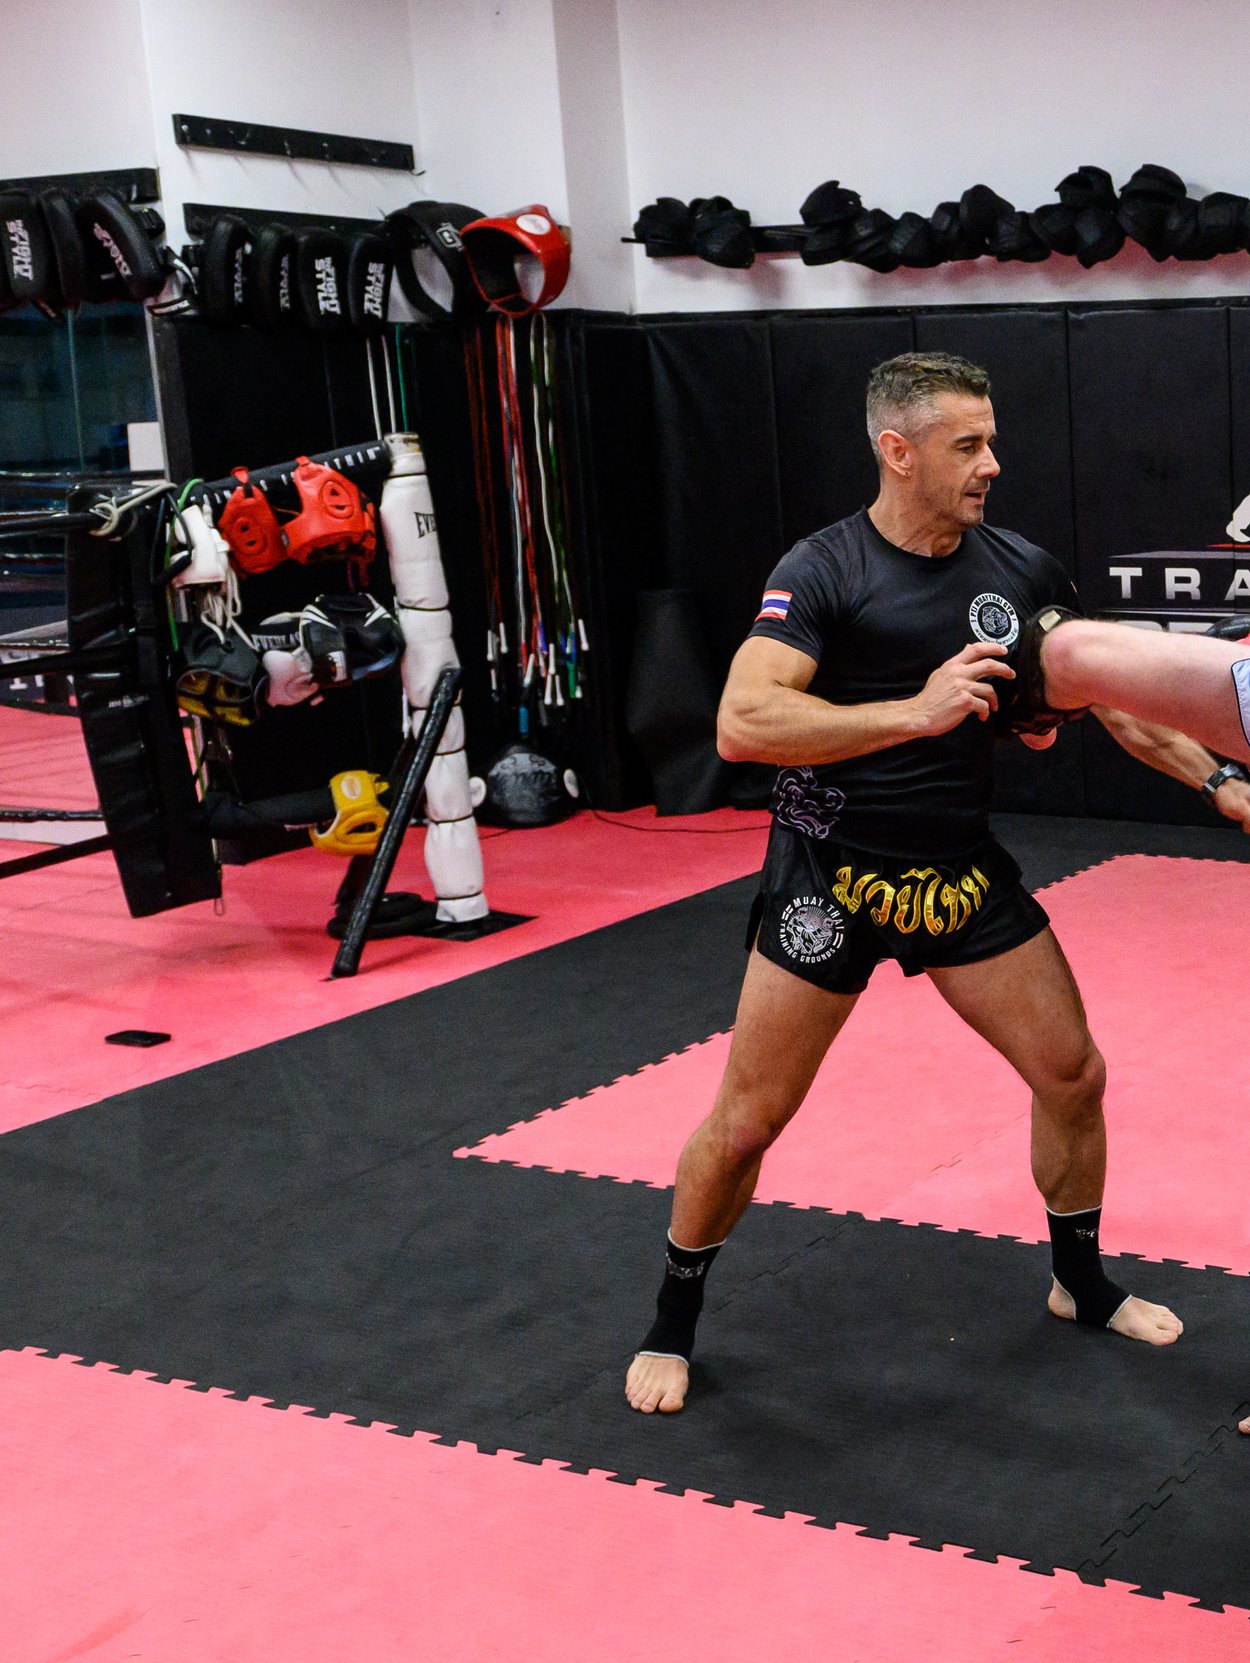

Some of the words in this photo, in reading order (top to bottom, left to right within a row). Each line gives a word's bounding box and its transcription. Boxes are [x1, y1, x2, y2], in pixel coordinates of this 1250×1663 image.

[314, 258, 329, 315] STYLE
[1003, 601, 1015, 616] GYM
[793, 896, 824, 908] MUAY
[827, 904, 845, 930] THAI
[780, 923, 798, 958] TRAINING
[800, 947, 836, 964] GROUNDS
